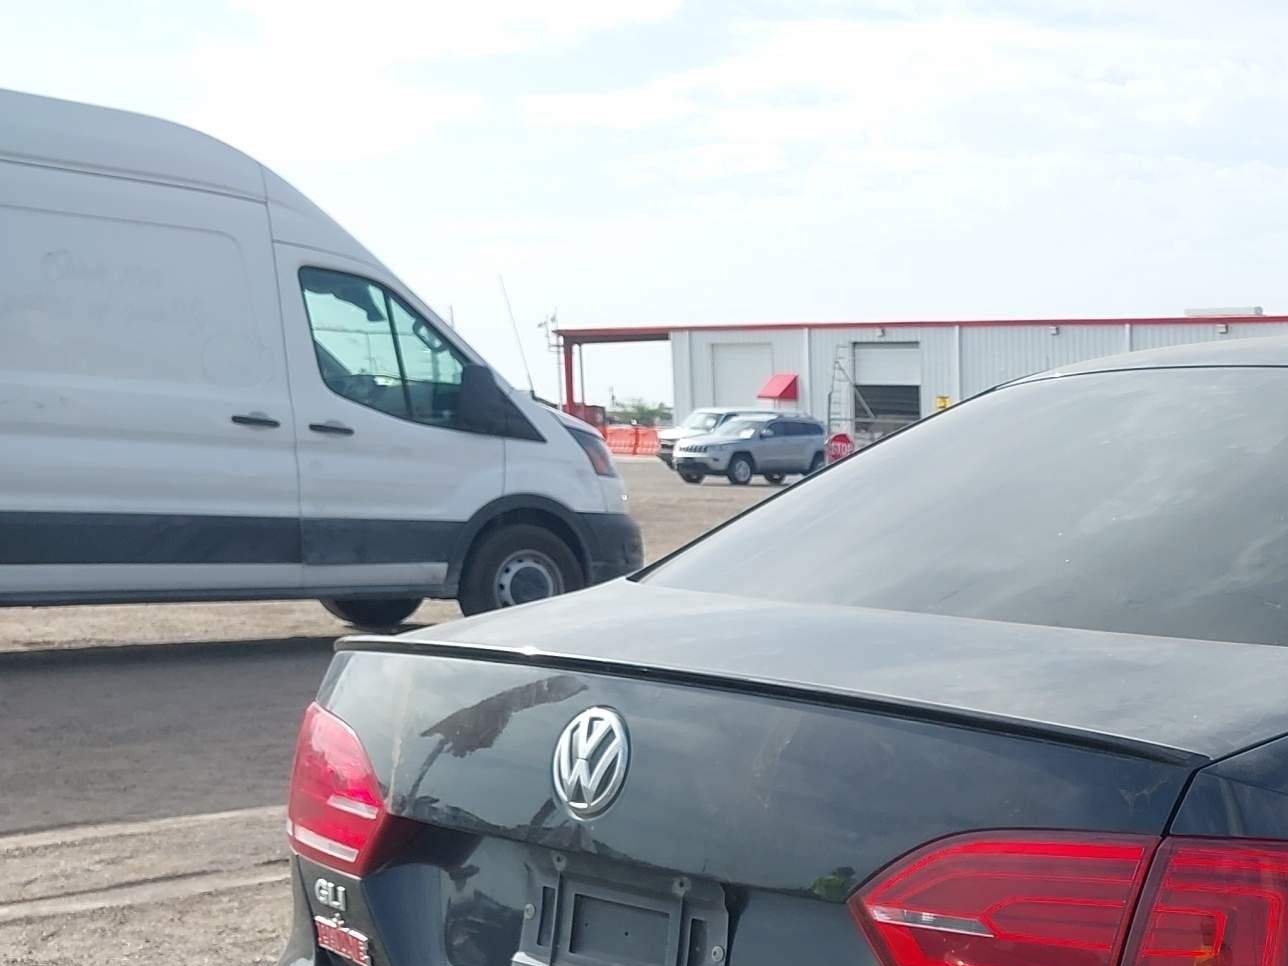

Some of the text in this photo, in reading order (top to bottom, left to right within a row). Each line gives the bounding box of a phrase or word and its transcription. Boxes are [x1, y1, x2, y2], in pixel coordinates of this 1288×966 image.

[830, 440, 854, 457] STOP
[552, 706, 630, 822] VW
[314, 878, 346, 911] GLI
